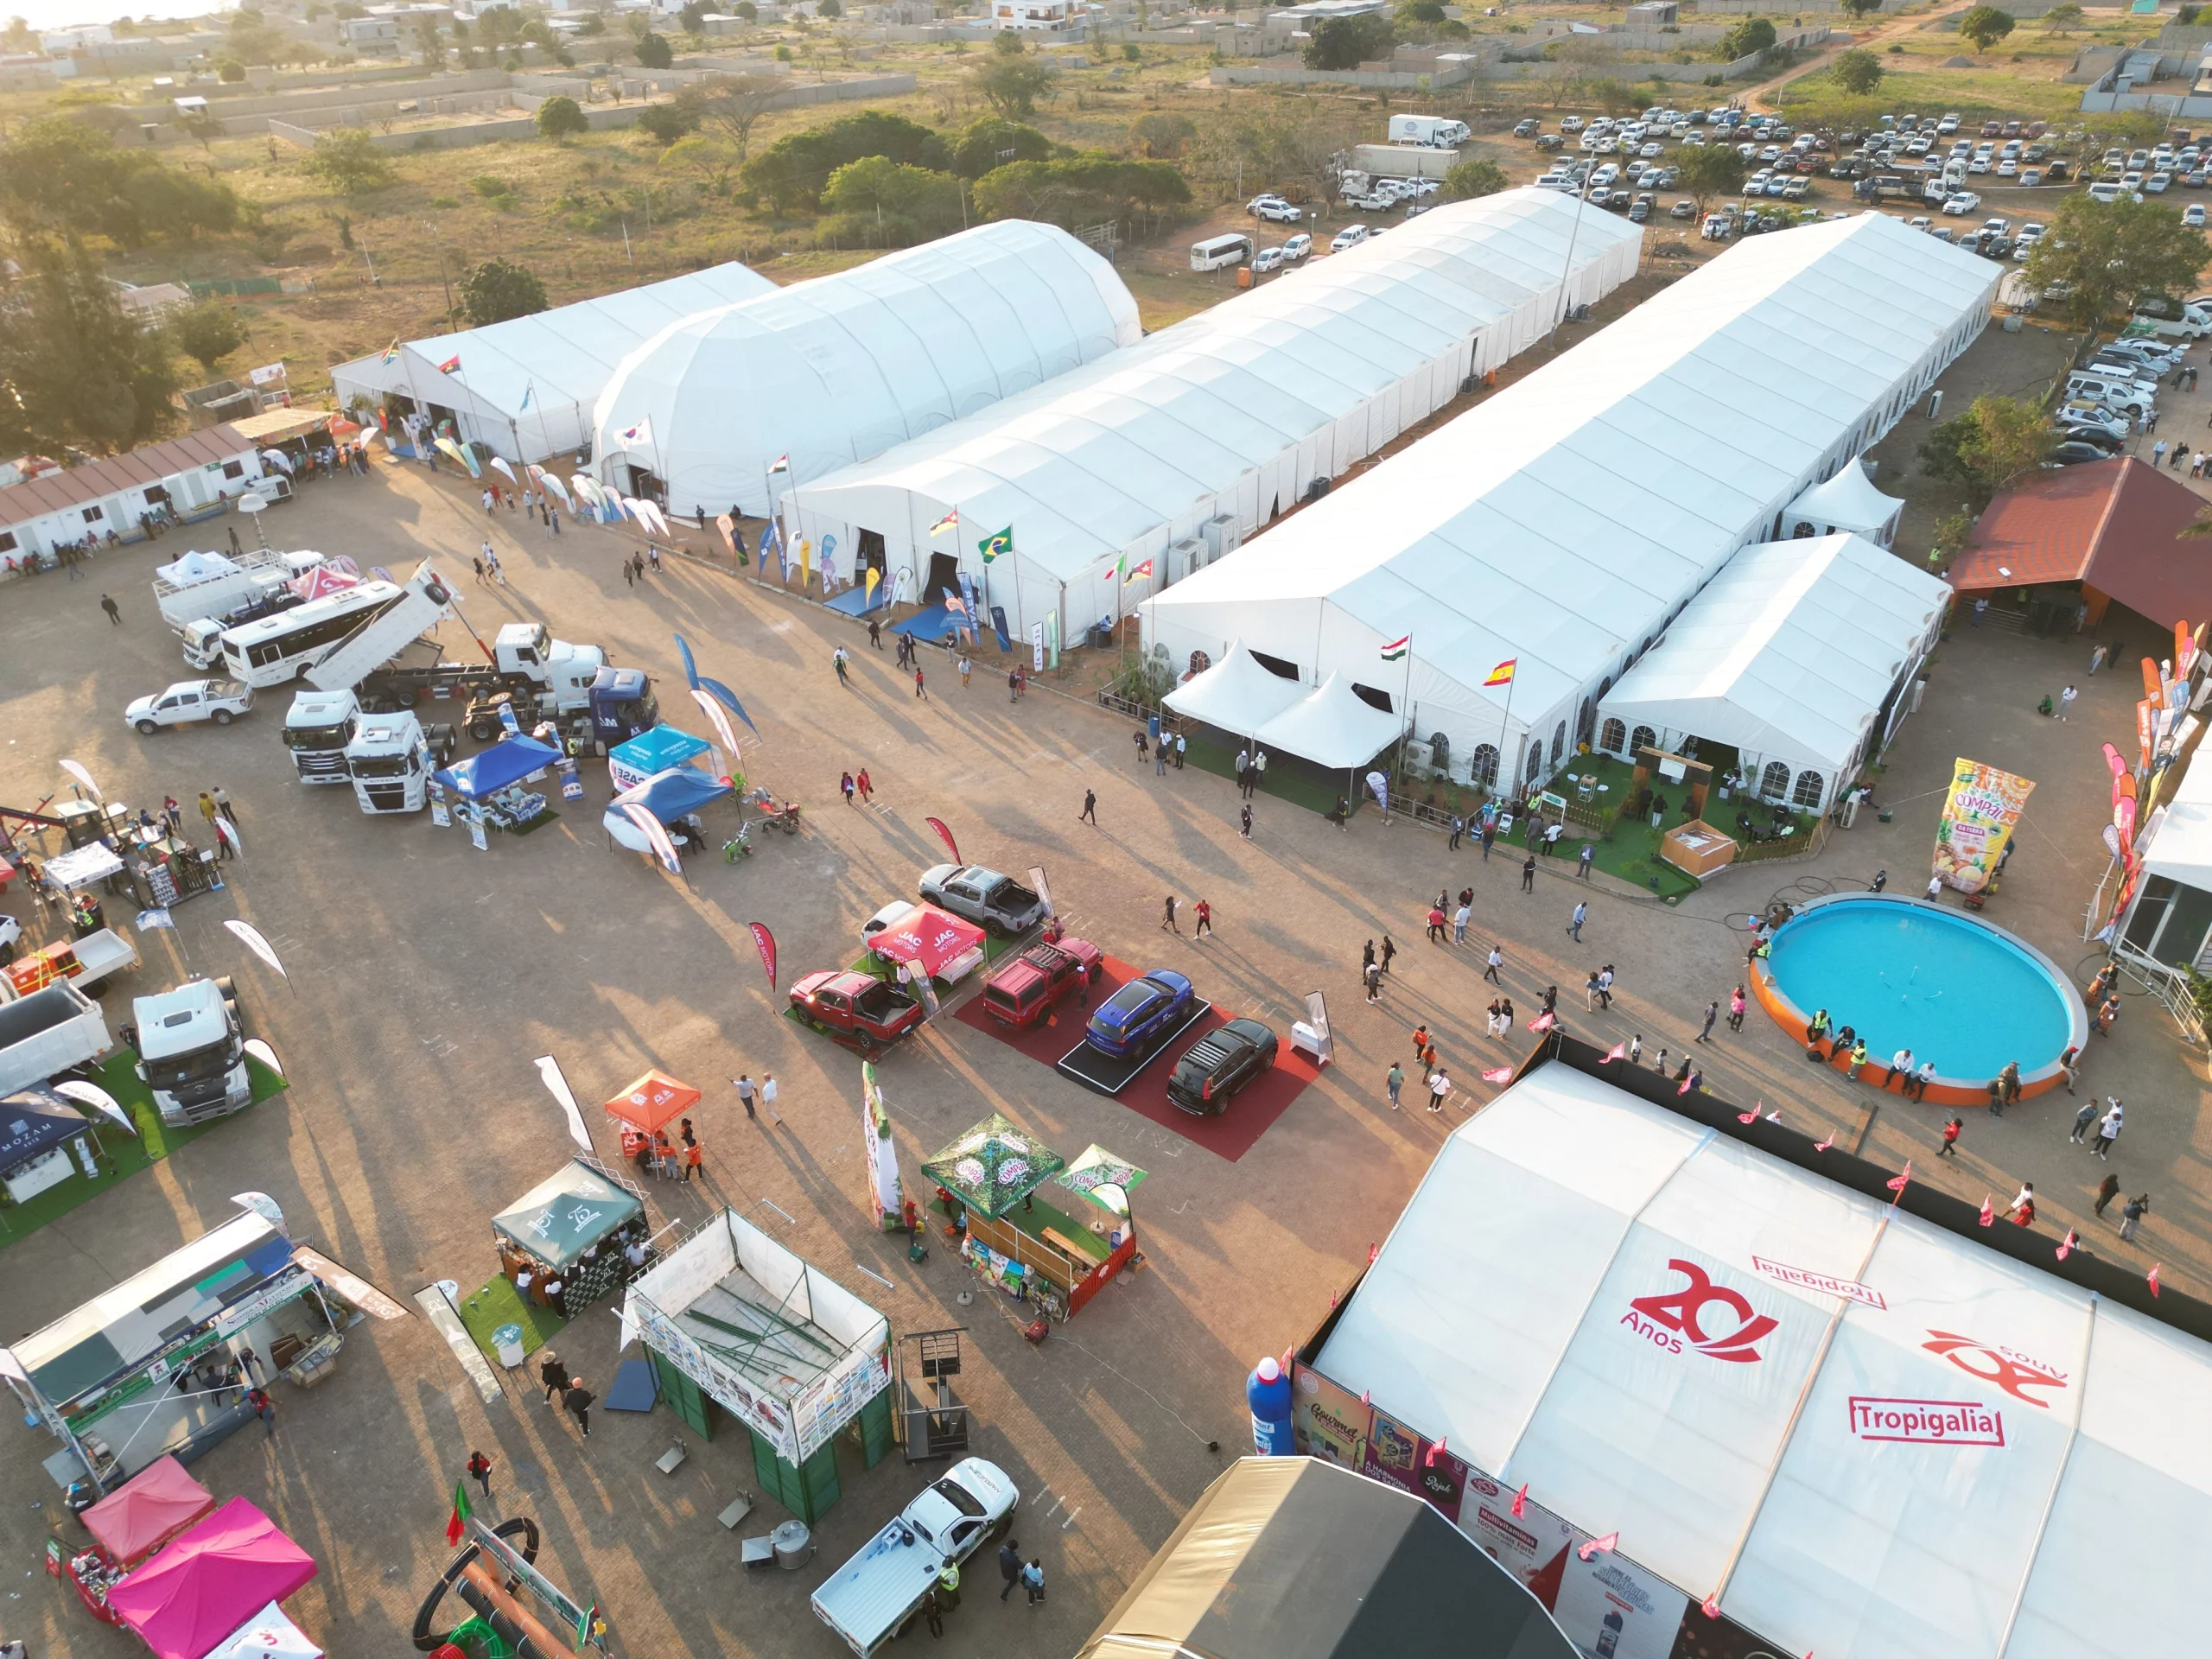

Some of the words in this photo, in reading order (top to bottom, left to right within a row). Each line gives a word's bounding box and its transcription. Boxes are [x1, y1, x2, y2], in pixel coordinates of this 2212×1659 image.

[876, 945, 894, 957] JAC
[893, 937, 918, 955] MOTORS
[899, 931, 923, 947] JAC
[933, 929, 955, 947] JAC
[937, 935, 962, 953] MOTORS
[938, 955, 954, 970] JAC
[954, 938, 978, 957] MOTORS
[1, 1122, 52, 1153] MOZAM
[1074, 1173, 1097, 1188] COMP
[1761, 1261, 1883, 1306] Tropigalia
[1620, 1310, 1683, 1355] Anos
[1999, 1345, 2069, 1380] Anos
[1310, 1402, 1359, 1440] Gourmet
[1858, 1405, 1994, 1438] Tropigalia
[1365, 1465, 1381, 1479] DOS
[1372, 1464, 1411, 1493] HARMONIA
[1425, 1475, 1452, 1494] Rajah
[1477, 1517, 1497, 1534] 100%
[1497, 1530, 1516, 1545] mais
[1517, 1540, 1536, 1557] Forte
[1480, 1510, 1535, 1547] Multivitaminas
[1618, 1590, 1655, 1615] SEGURAS
